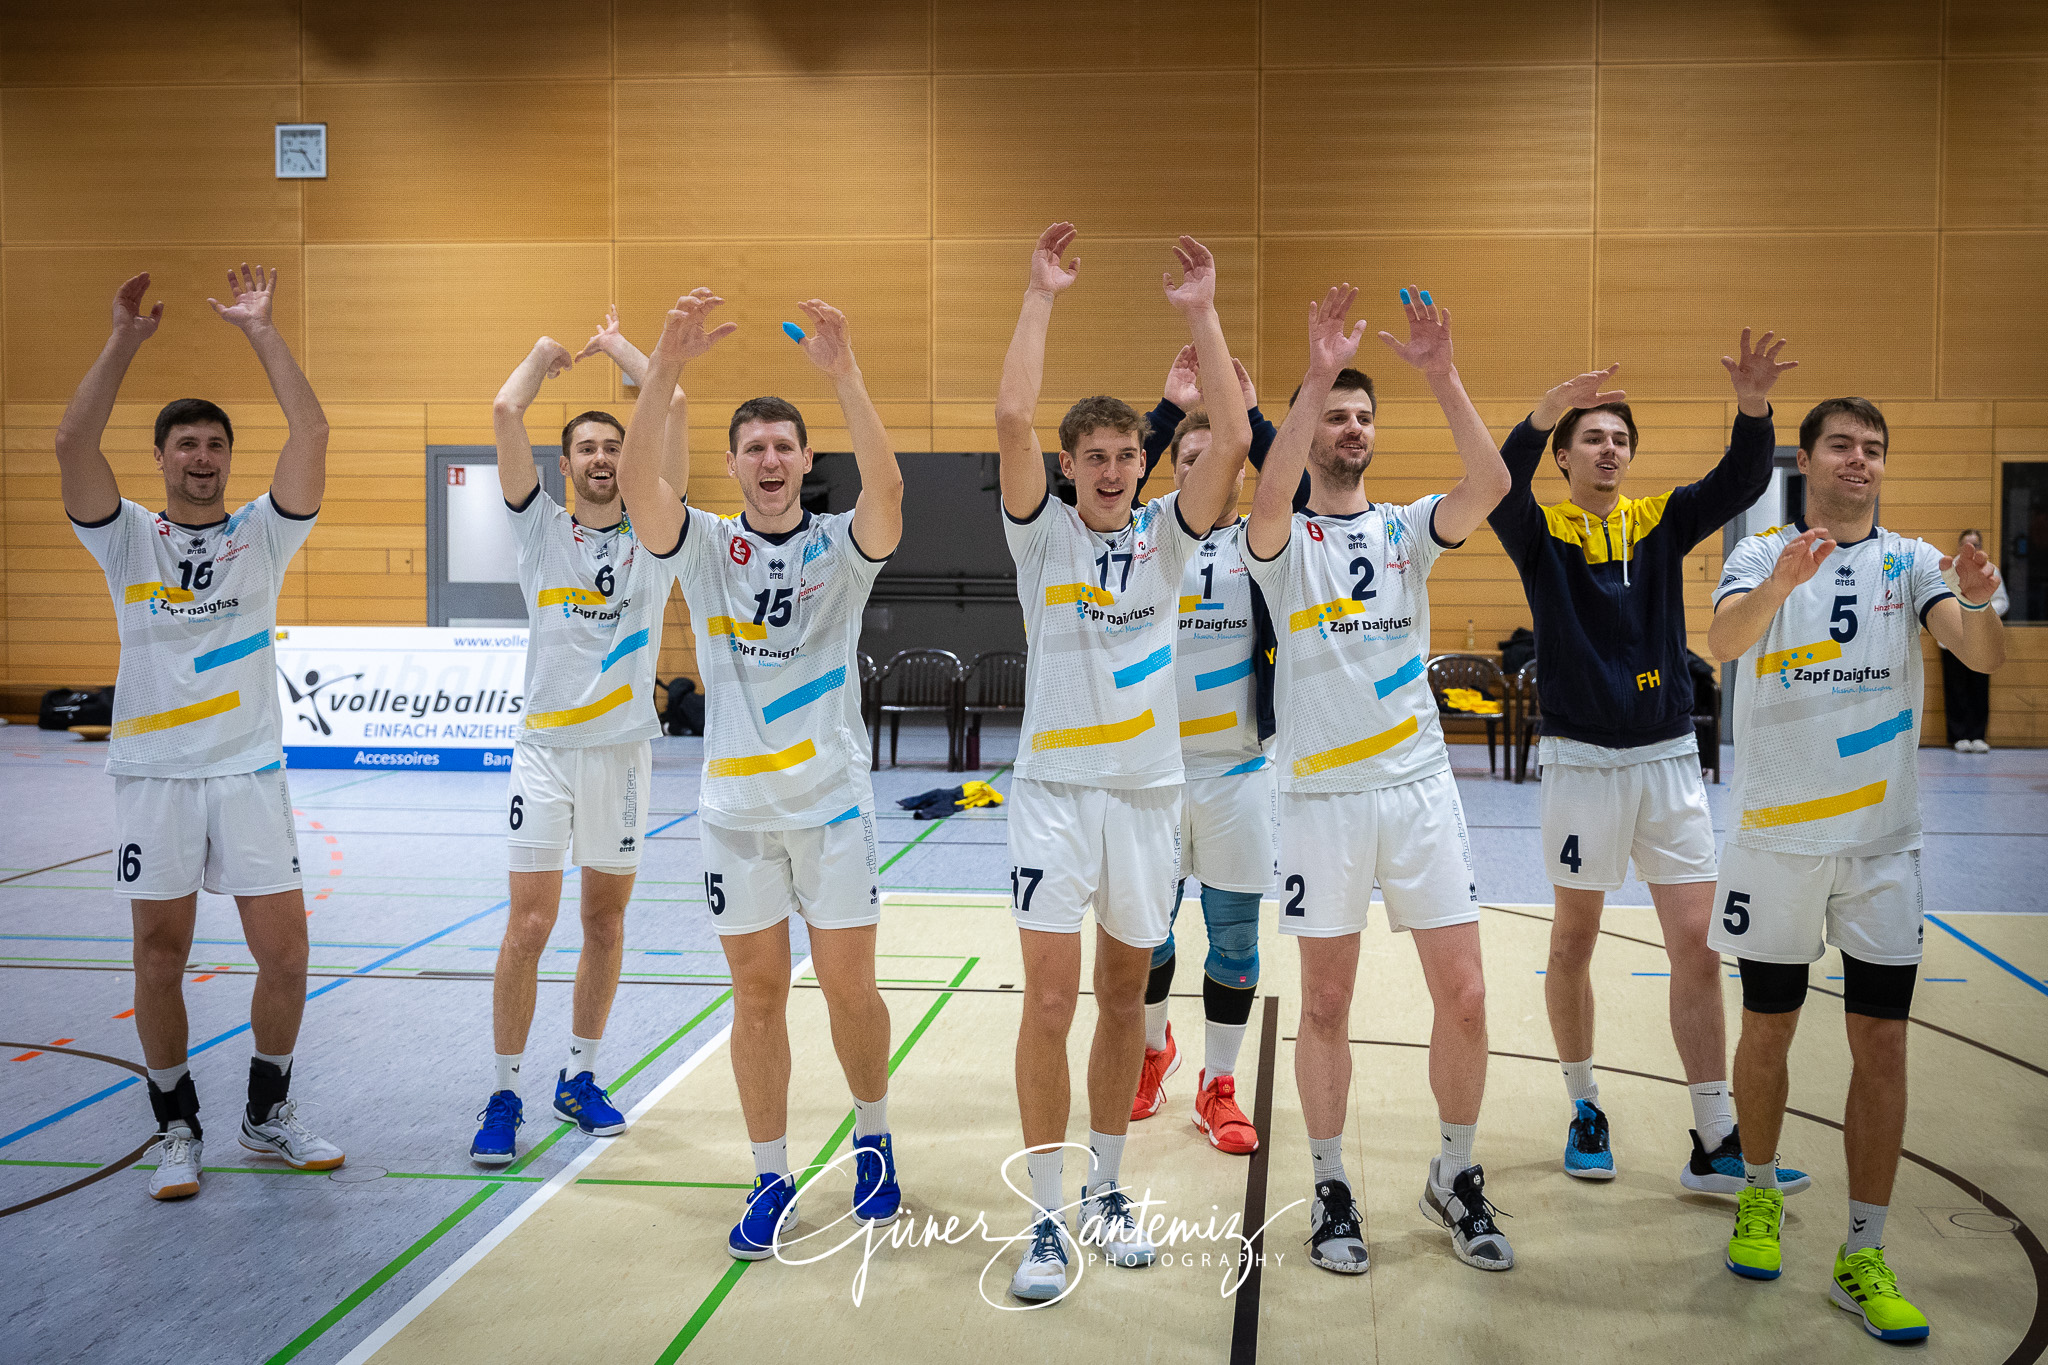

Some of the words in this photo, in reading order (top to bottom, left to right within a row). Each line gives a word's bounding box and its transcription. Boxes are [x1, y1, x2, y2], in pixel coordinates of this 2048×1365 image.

[178, 559, 214, 590] 16
[595, 564, 615, 597] 6
[1095, 551, 1133, 593] 17
[1200, 563, 1214, 600] 1
[1350, 556, 1377, 602] 2
[1835, 578, 1856, 586] erea
[753, 587, 794, 627] 15
[1829, 594, 1858, 643] 5
[1178, 618, 1194, 630] pf
[1195, 618, 1248, 632] Daigfuss
[1330, 619, 1360, 635] Zapf
[1264, 646, 1277, 665] Y
[1636, 669, 1661, 691] FH
[1794, 668, 1831, 684] Zapf
[330, 688, 524, 719] volleyballis
[363, 722, 438, 739] EINFACH
[353, 750, 440, 766] Accessoires
[509, 794, 524, 831] 6
[1559, 833, 1582, 874] 4
[1011, 865, 1044, 912] 17
[1285, 873, 1306, 917] 2
[1722, 889, 1751, 936] 5
